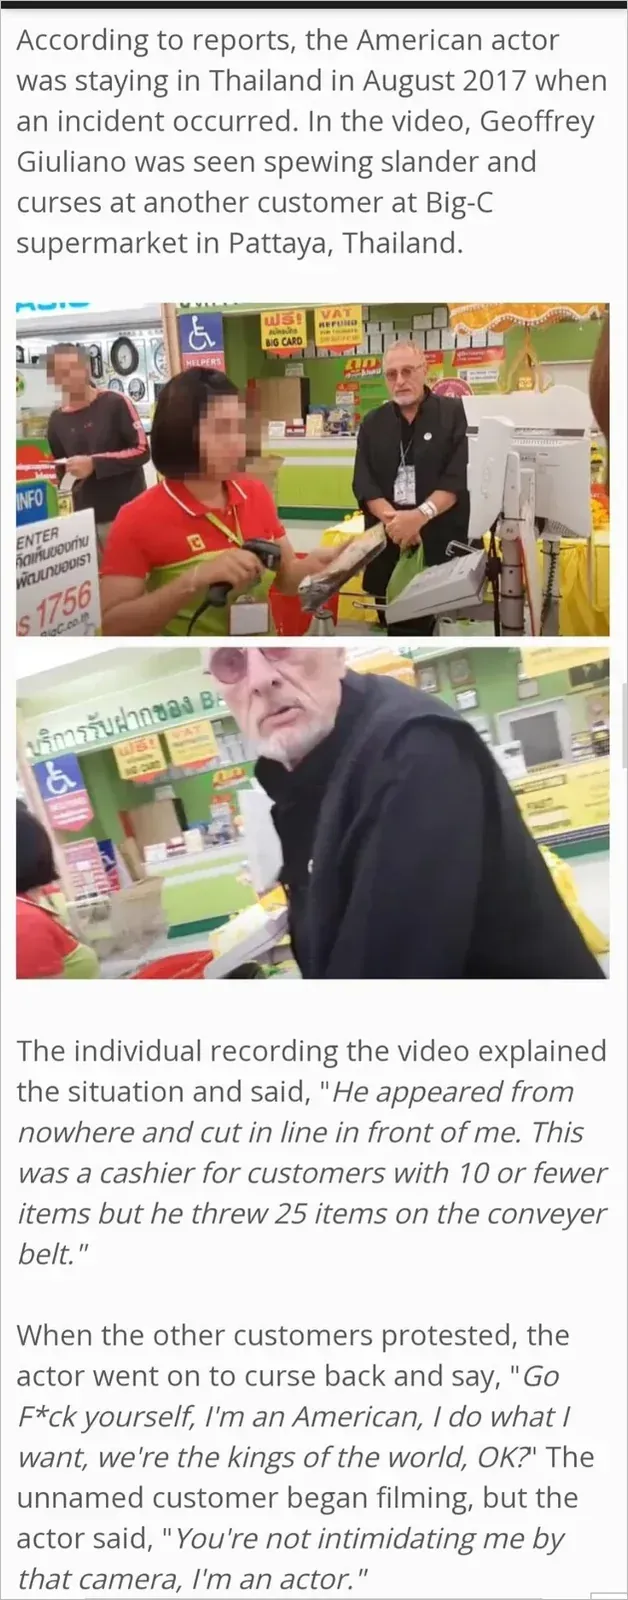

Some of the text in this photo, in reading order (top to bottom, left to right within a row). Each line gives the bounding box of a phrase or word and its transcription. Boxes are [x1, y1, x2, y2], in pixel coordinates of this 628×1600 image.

[320, 307, 353, 320] VAT
[265, 336, 303, 347] BIG CARD
[186, 358, 222, 368] HELPERS
[16, 526, 59, 550] ENTER
[36, 580, 92, 629] 1756
